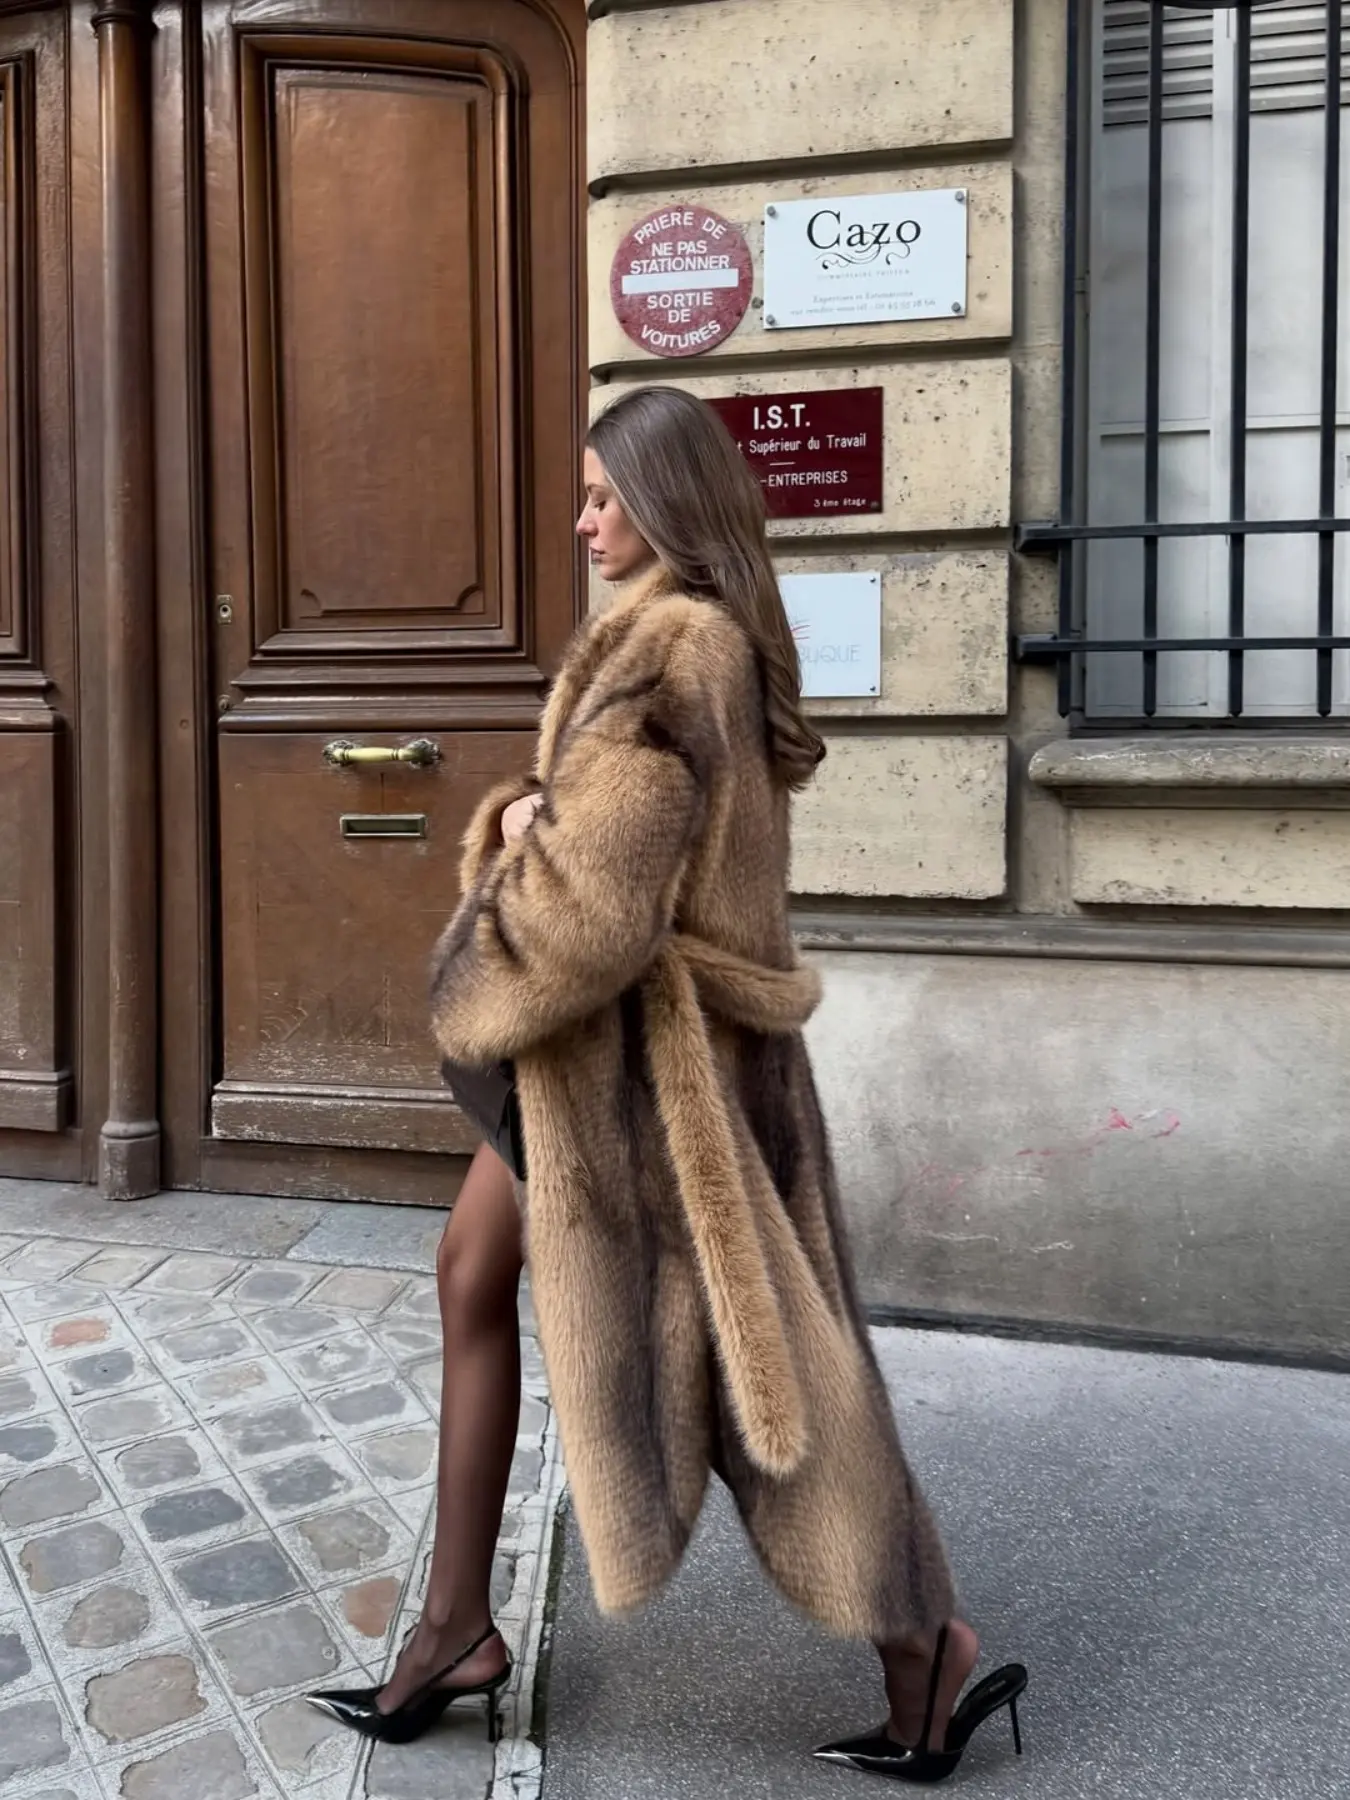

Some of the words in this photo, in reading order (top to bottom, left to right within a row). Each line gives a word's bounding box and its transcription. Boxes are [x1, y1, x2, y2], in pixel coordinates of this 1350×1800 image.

[634, 212, 694, 244] PRIERE
[702, 217, 726, 240] DE
[807, 210, 921, 249] Cazo
[652, 242, 673, 256] NE
[677, 240, 707, 255] PAS
[630, 255, 729, 275] STATIONNER
[647, 292, 713, 309] SORTIE
[668, 309, 691, 323] DE
[641, 320, 721, 348] VOITURES
[753, 403, 811, 430] I.S.T.
[749, 437, 801, 456] Supérieur
[808, 436, 820, 450] du
[826, 433, 867, 449] Travail
